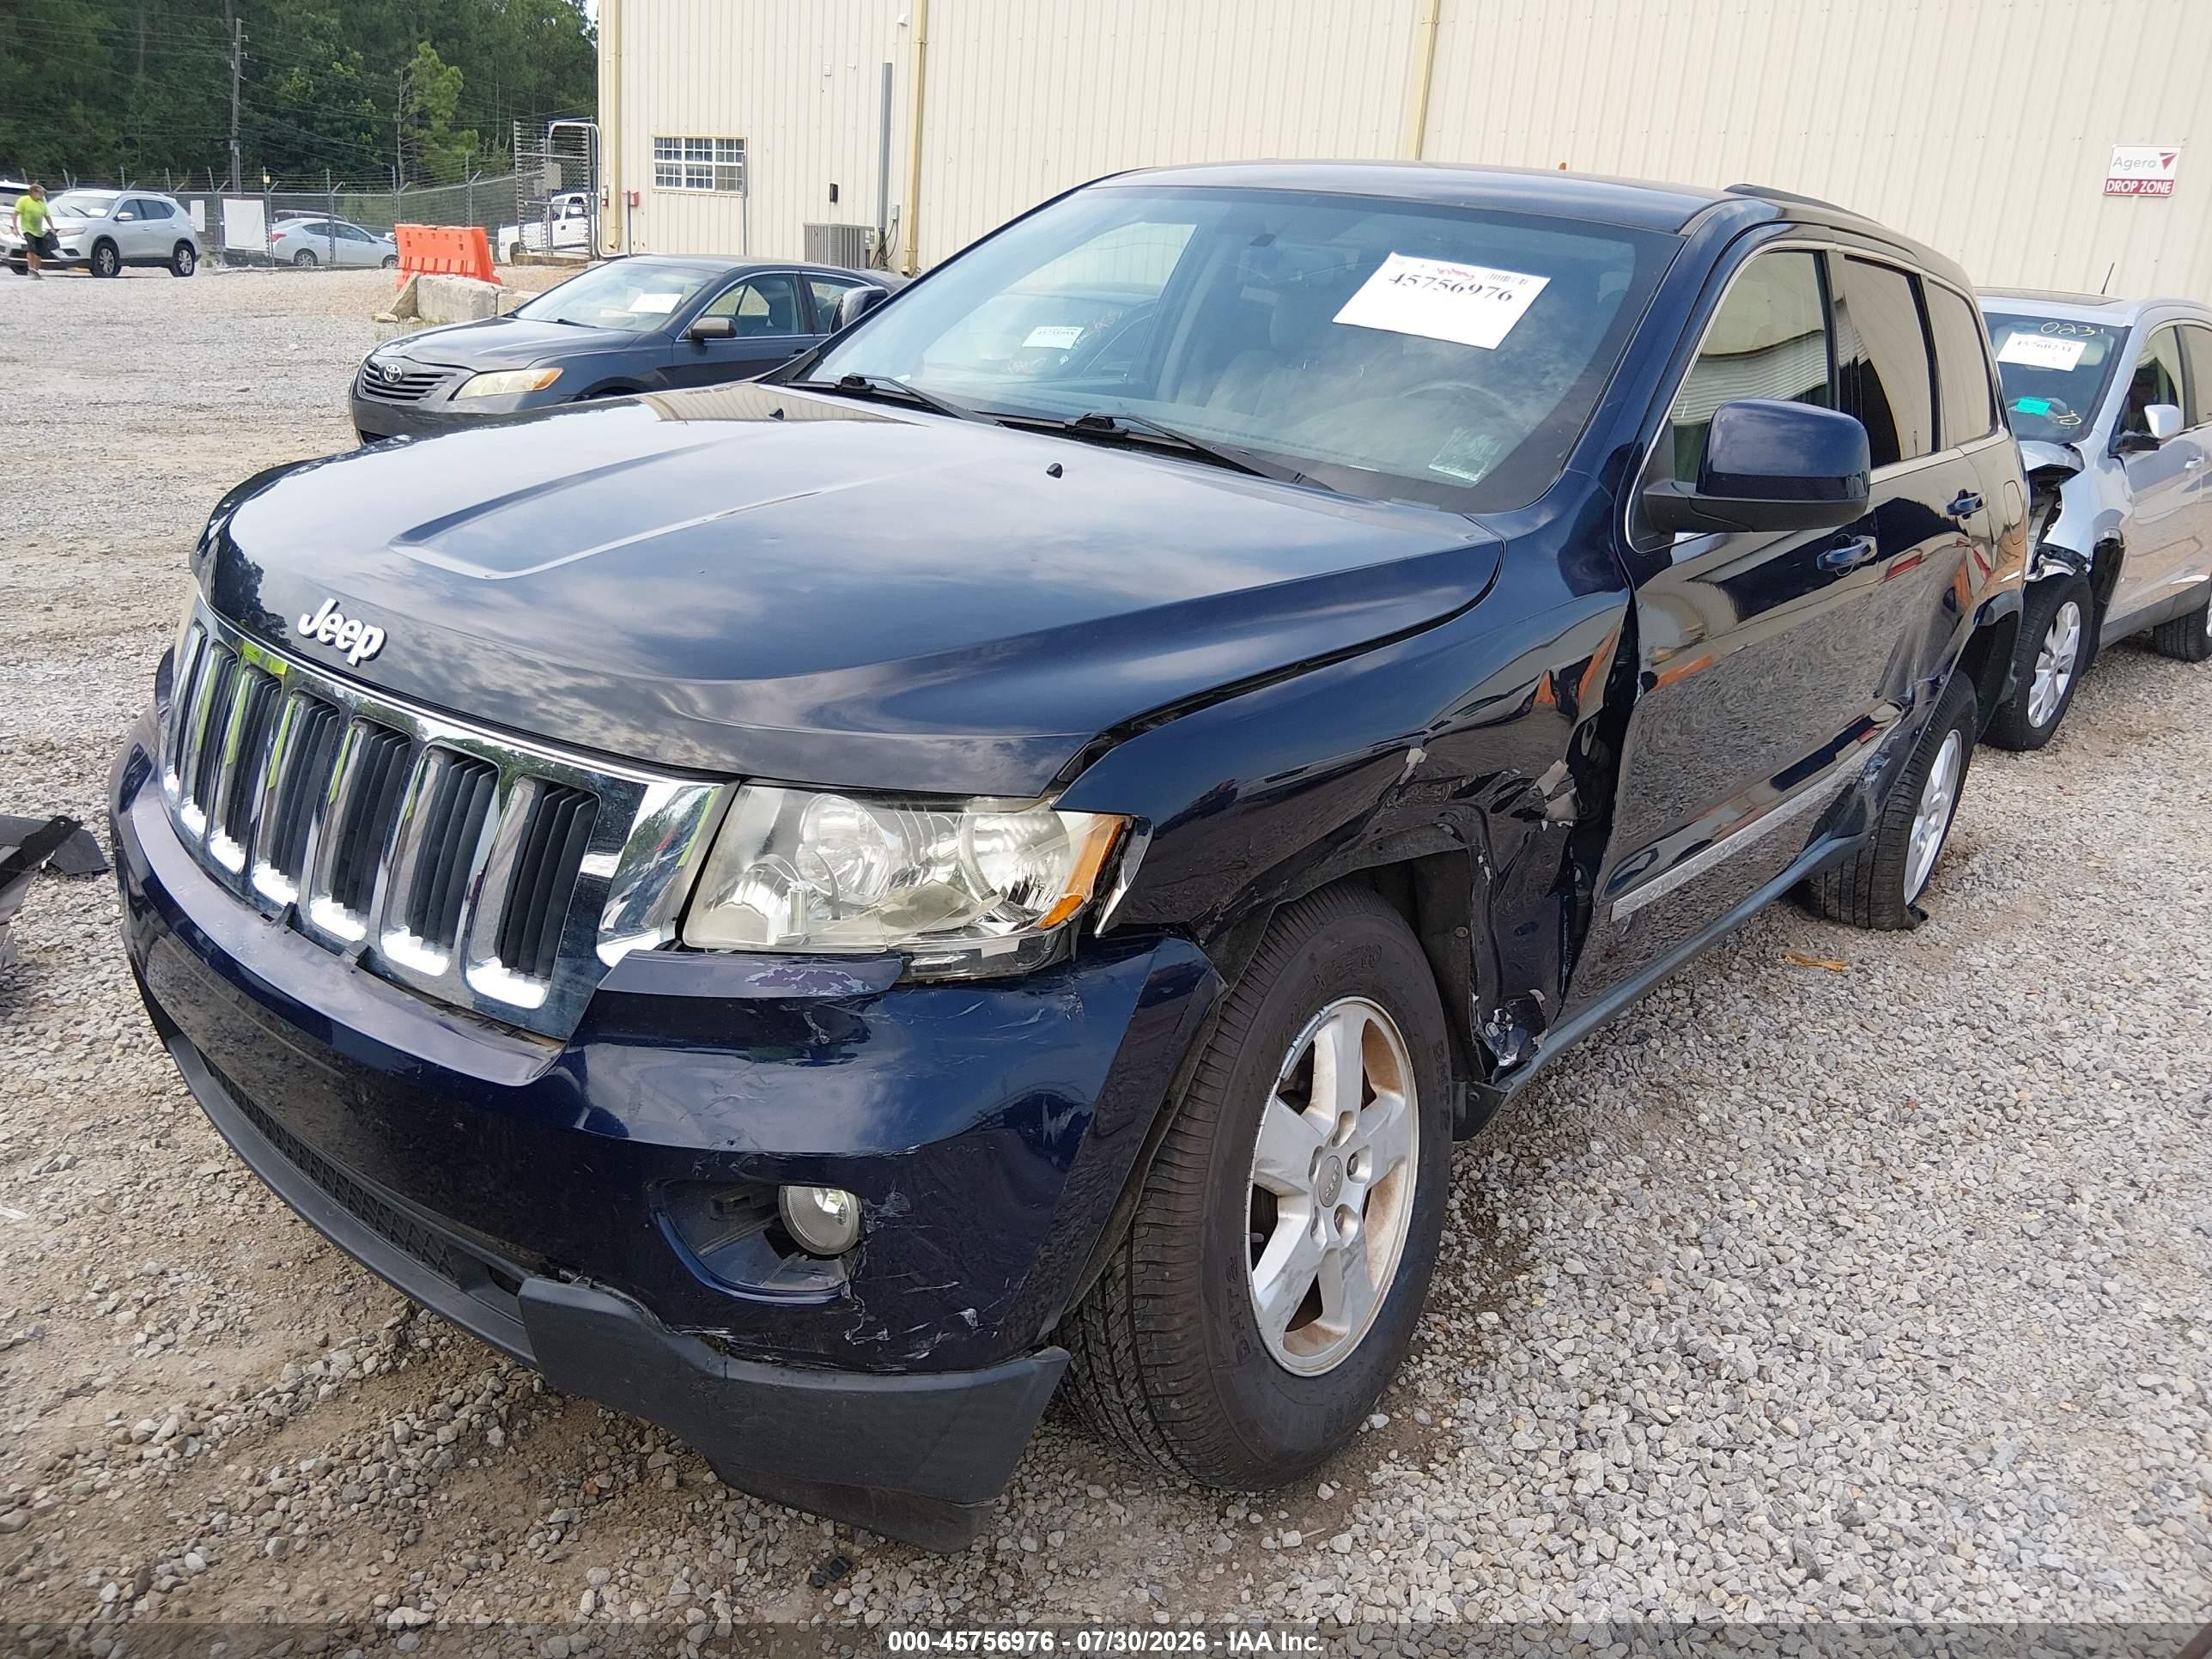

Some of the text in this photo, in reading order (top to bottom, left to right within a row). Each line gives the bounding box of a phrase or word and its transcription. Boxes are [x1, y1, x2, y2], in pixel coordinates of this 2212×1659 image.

[2112, 156, 2157, 171] Agero
[2106, 179, 2172, 194] DROP ZONE
[1388, 272, 1513, 302] 45756976
[297, 597, 387, 668] Jeep
